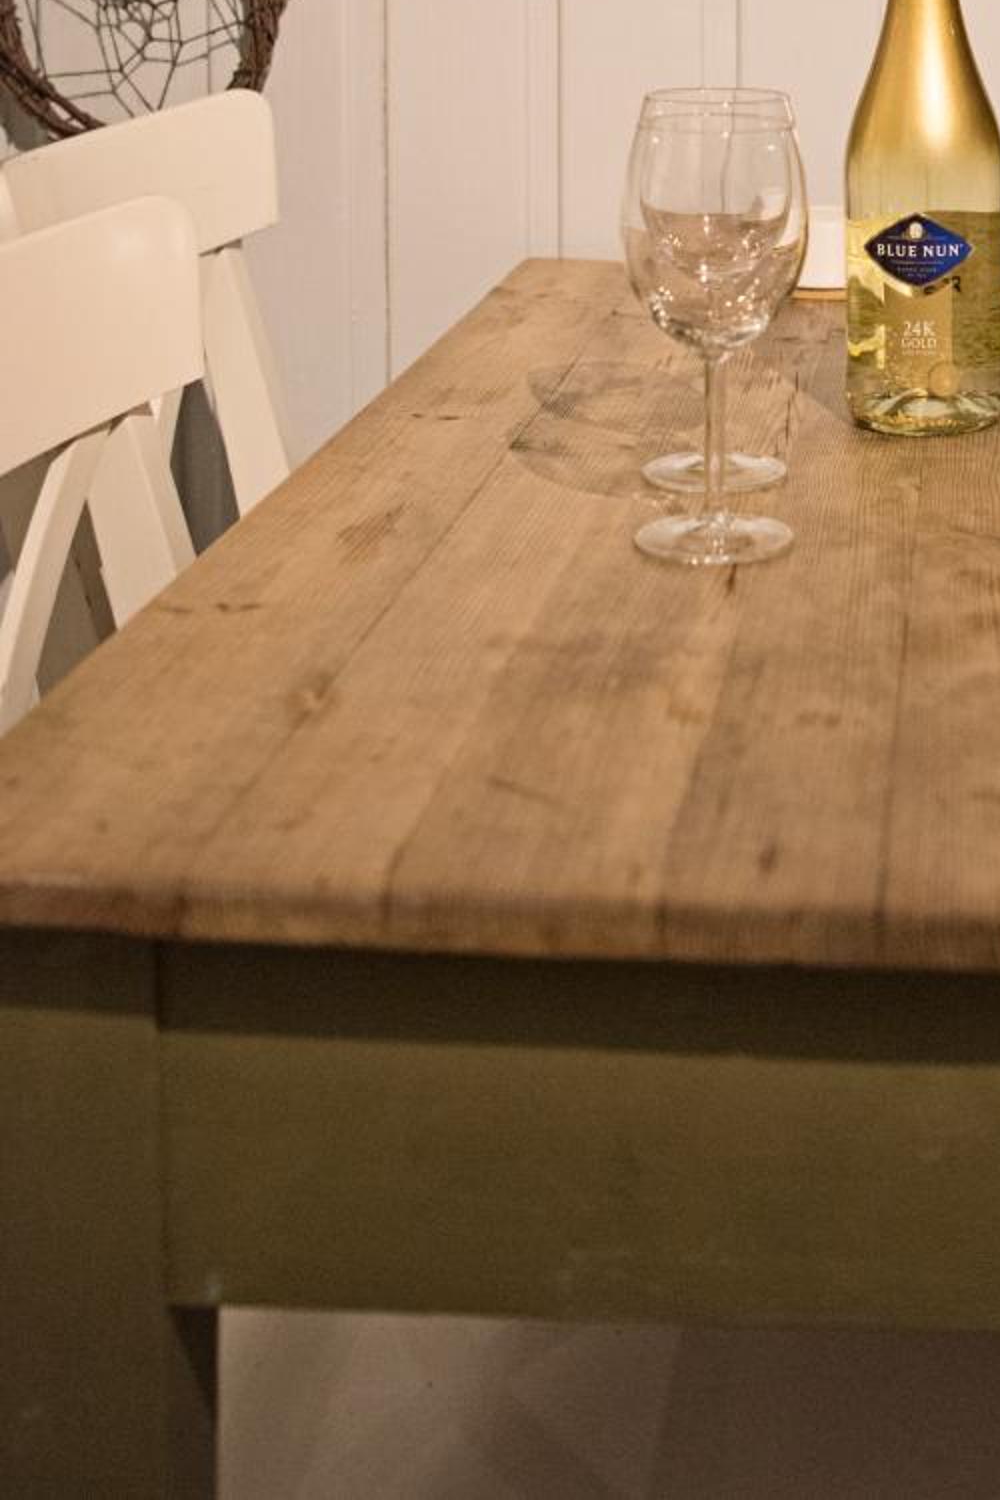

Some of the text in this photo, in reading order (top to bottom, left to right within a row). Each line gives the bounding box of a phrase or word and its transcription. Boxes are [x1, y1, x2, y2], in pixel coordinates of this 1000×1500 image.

[876, 243, 961, 258] BLUE NUN
[902, 320, 937, 338] 24K
[901, 337, 937, 349] GOLD
